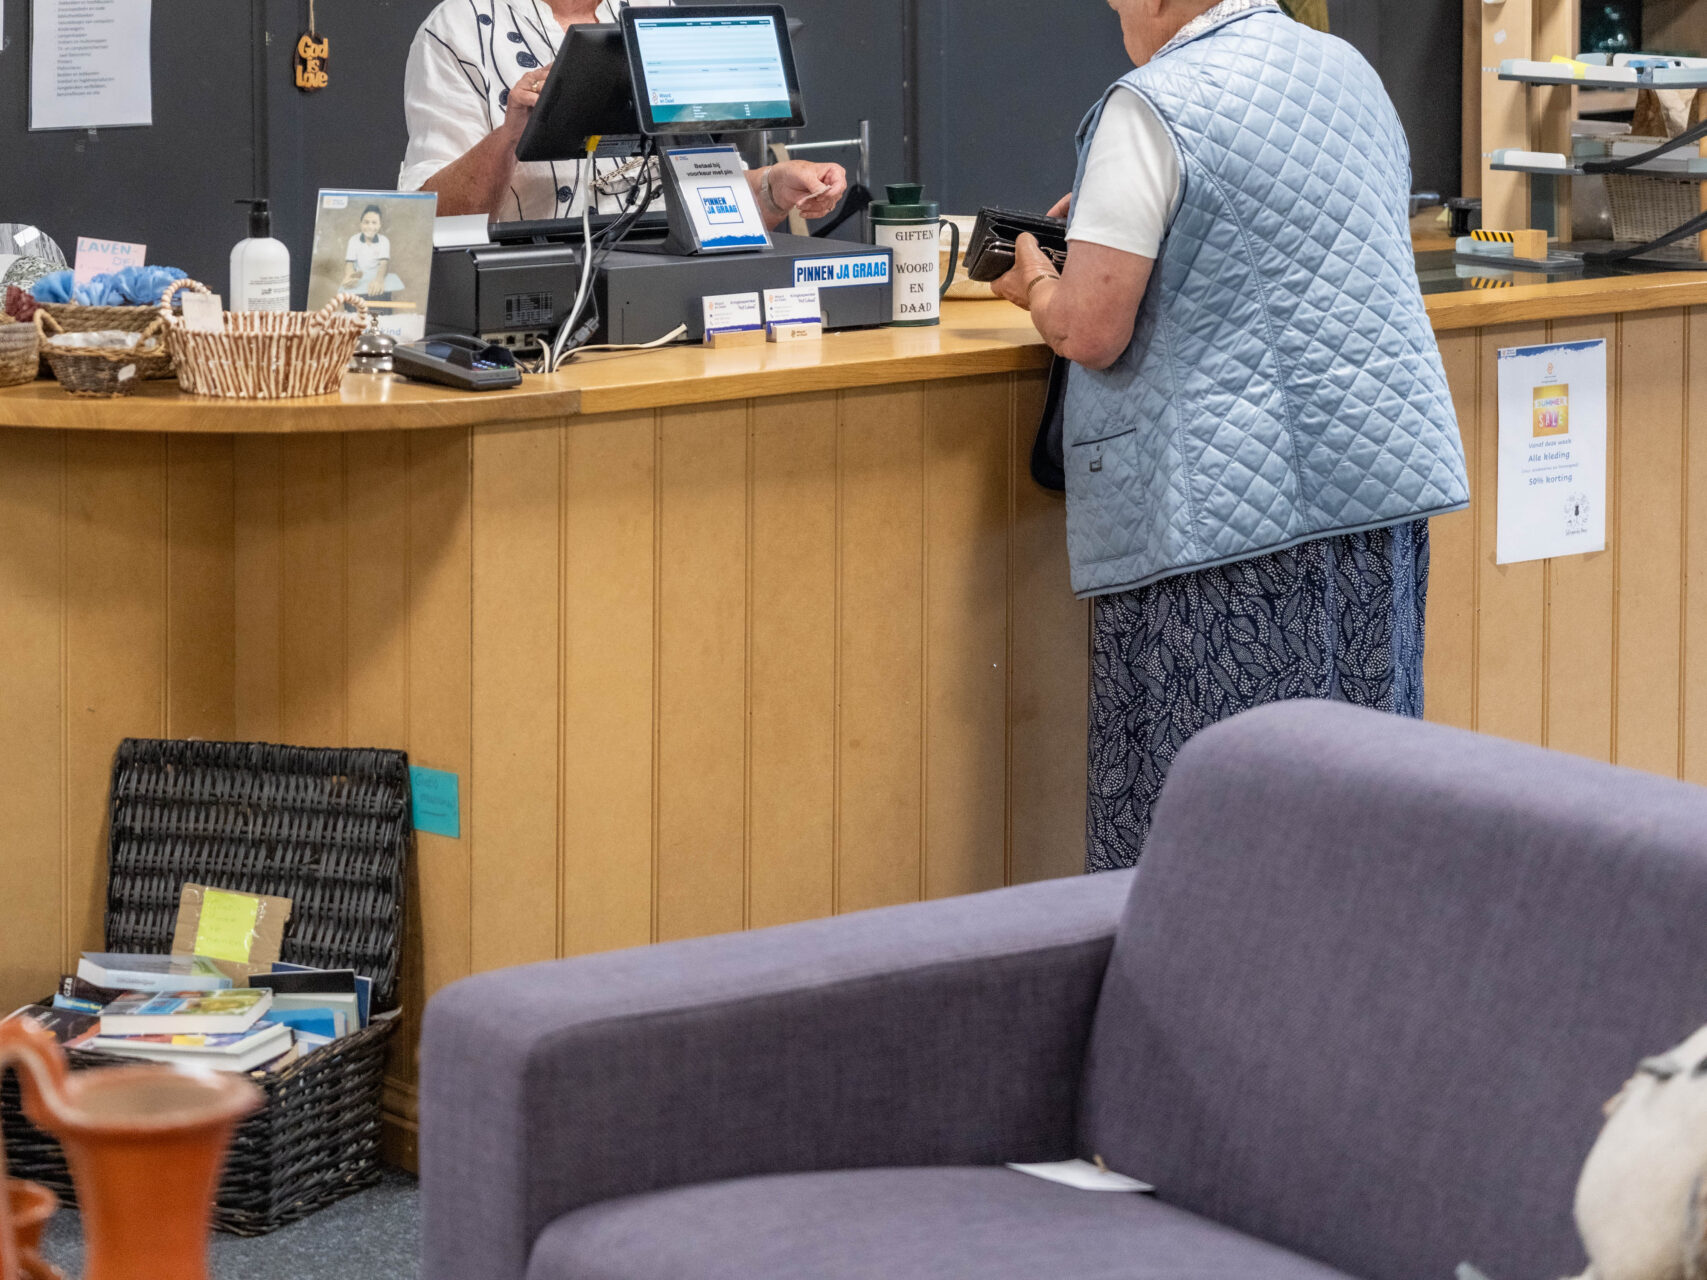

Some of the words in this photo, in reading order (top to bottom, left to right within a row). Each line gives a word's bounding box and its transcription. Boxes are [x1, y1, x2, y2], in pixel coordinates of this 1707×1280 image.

[297, 35, 329, 59] God
[307, 56, 320, 72] is
[296, 65, 329, 88] Love
[703, 196, 727, 206] PINNEN
[707, 206, 716, 214] JA
[717, 205, 738, 214] GRAAG
[895, 230, 934, 241] GIFTEN
[797, 265, 834, 282] PINNEN
[836, 264, 850, 280] JA
[852, 261, 887, 279] GRAAG
[895, 262, 934, 274] WOORD
[910, 283, 924, 293] EN
[900, 302, 932, 314] DAAD
[1538, 413, 1564, 428] SALE
[1528, 454, 1542, 462] Alle
[1544, 451, 1570, 460] kleding
[1529, 478, 1544, 486] 50%
[1545, 474, 1573, 483] korting
